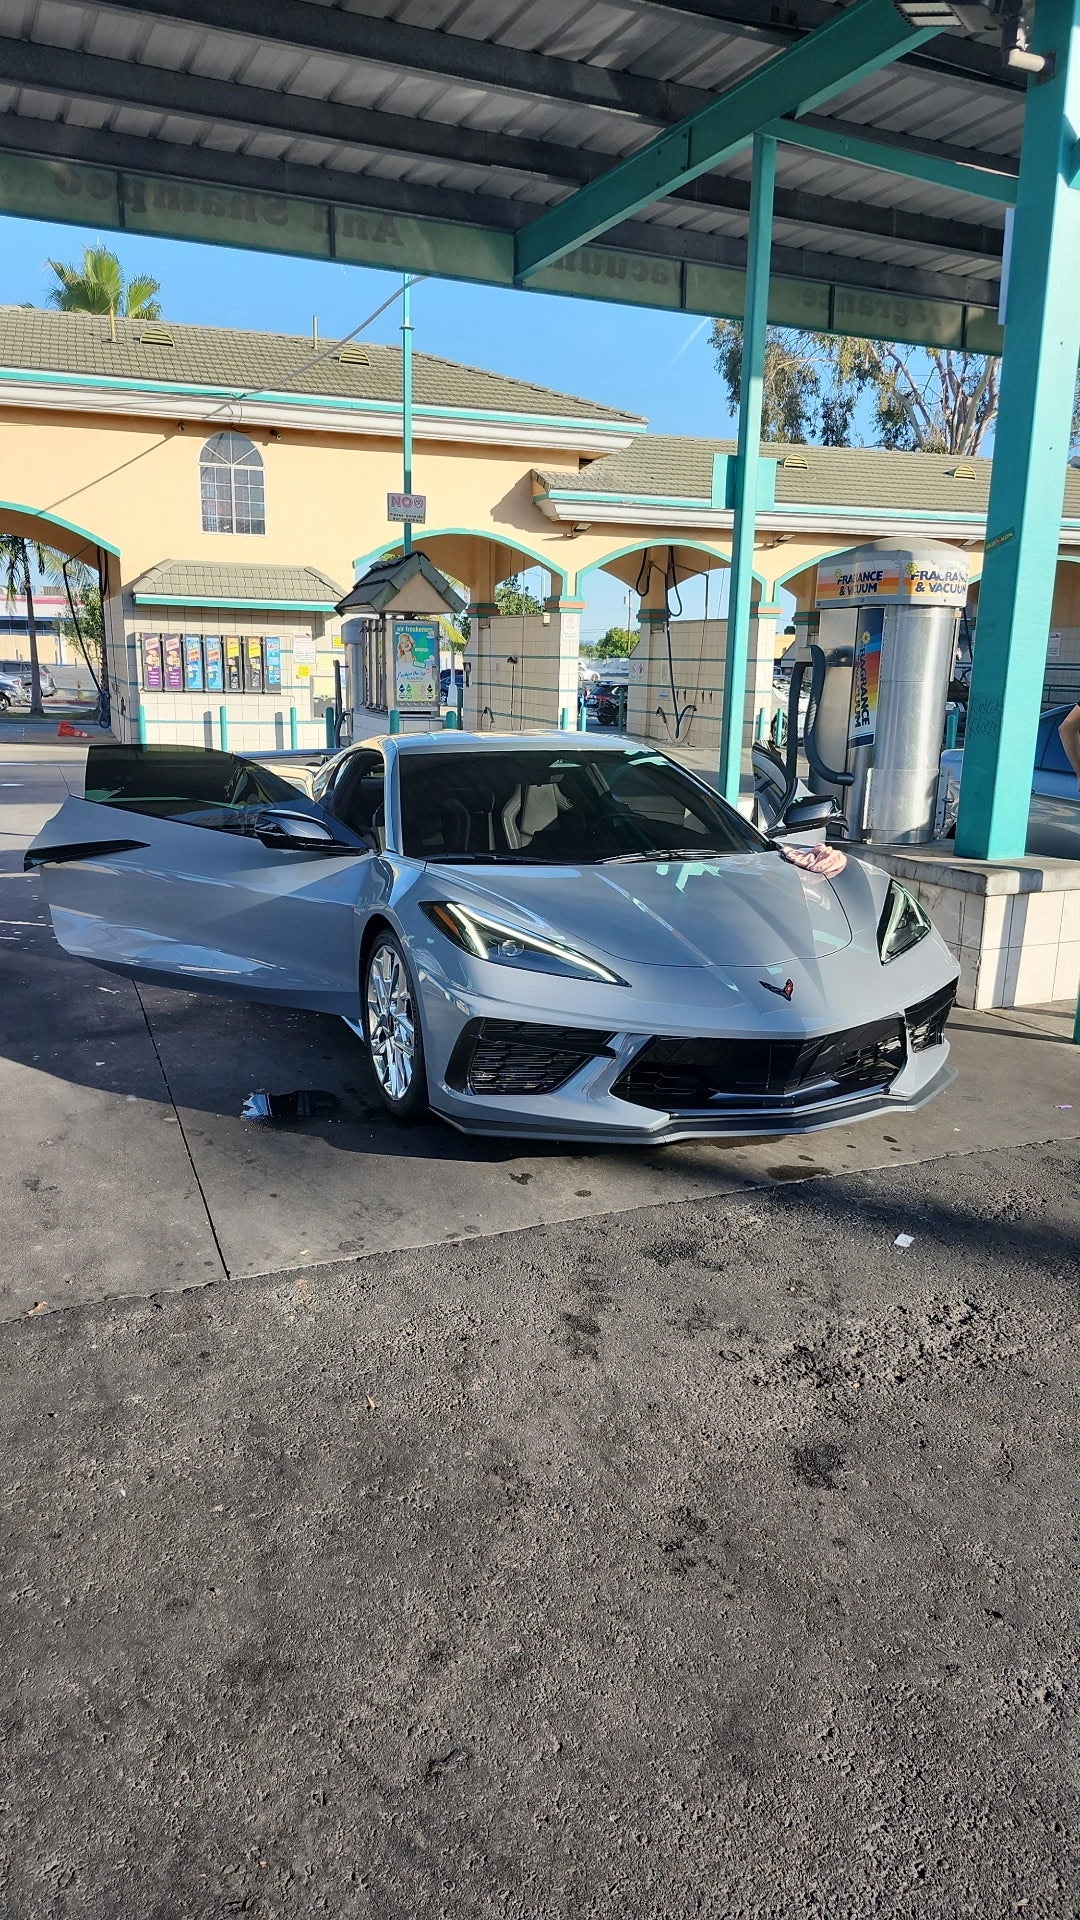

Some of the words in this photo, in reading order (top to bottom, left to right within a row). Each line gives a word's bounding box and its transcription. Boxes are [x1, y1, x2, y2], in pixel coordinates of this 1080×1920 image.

[837, 570, 884, 586] FRAANCE
[839, 586, 846, 596] &
[847, 582, 878, 595] VUUM
[915, 582, 925, 592] &
